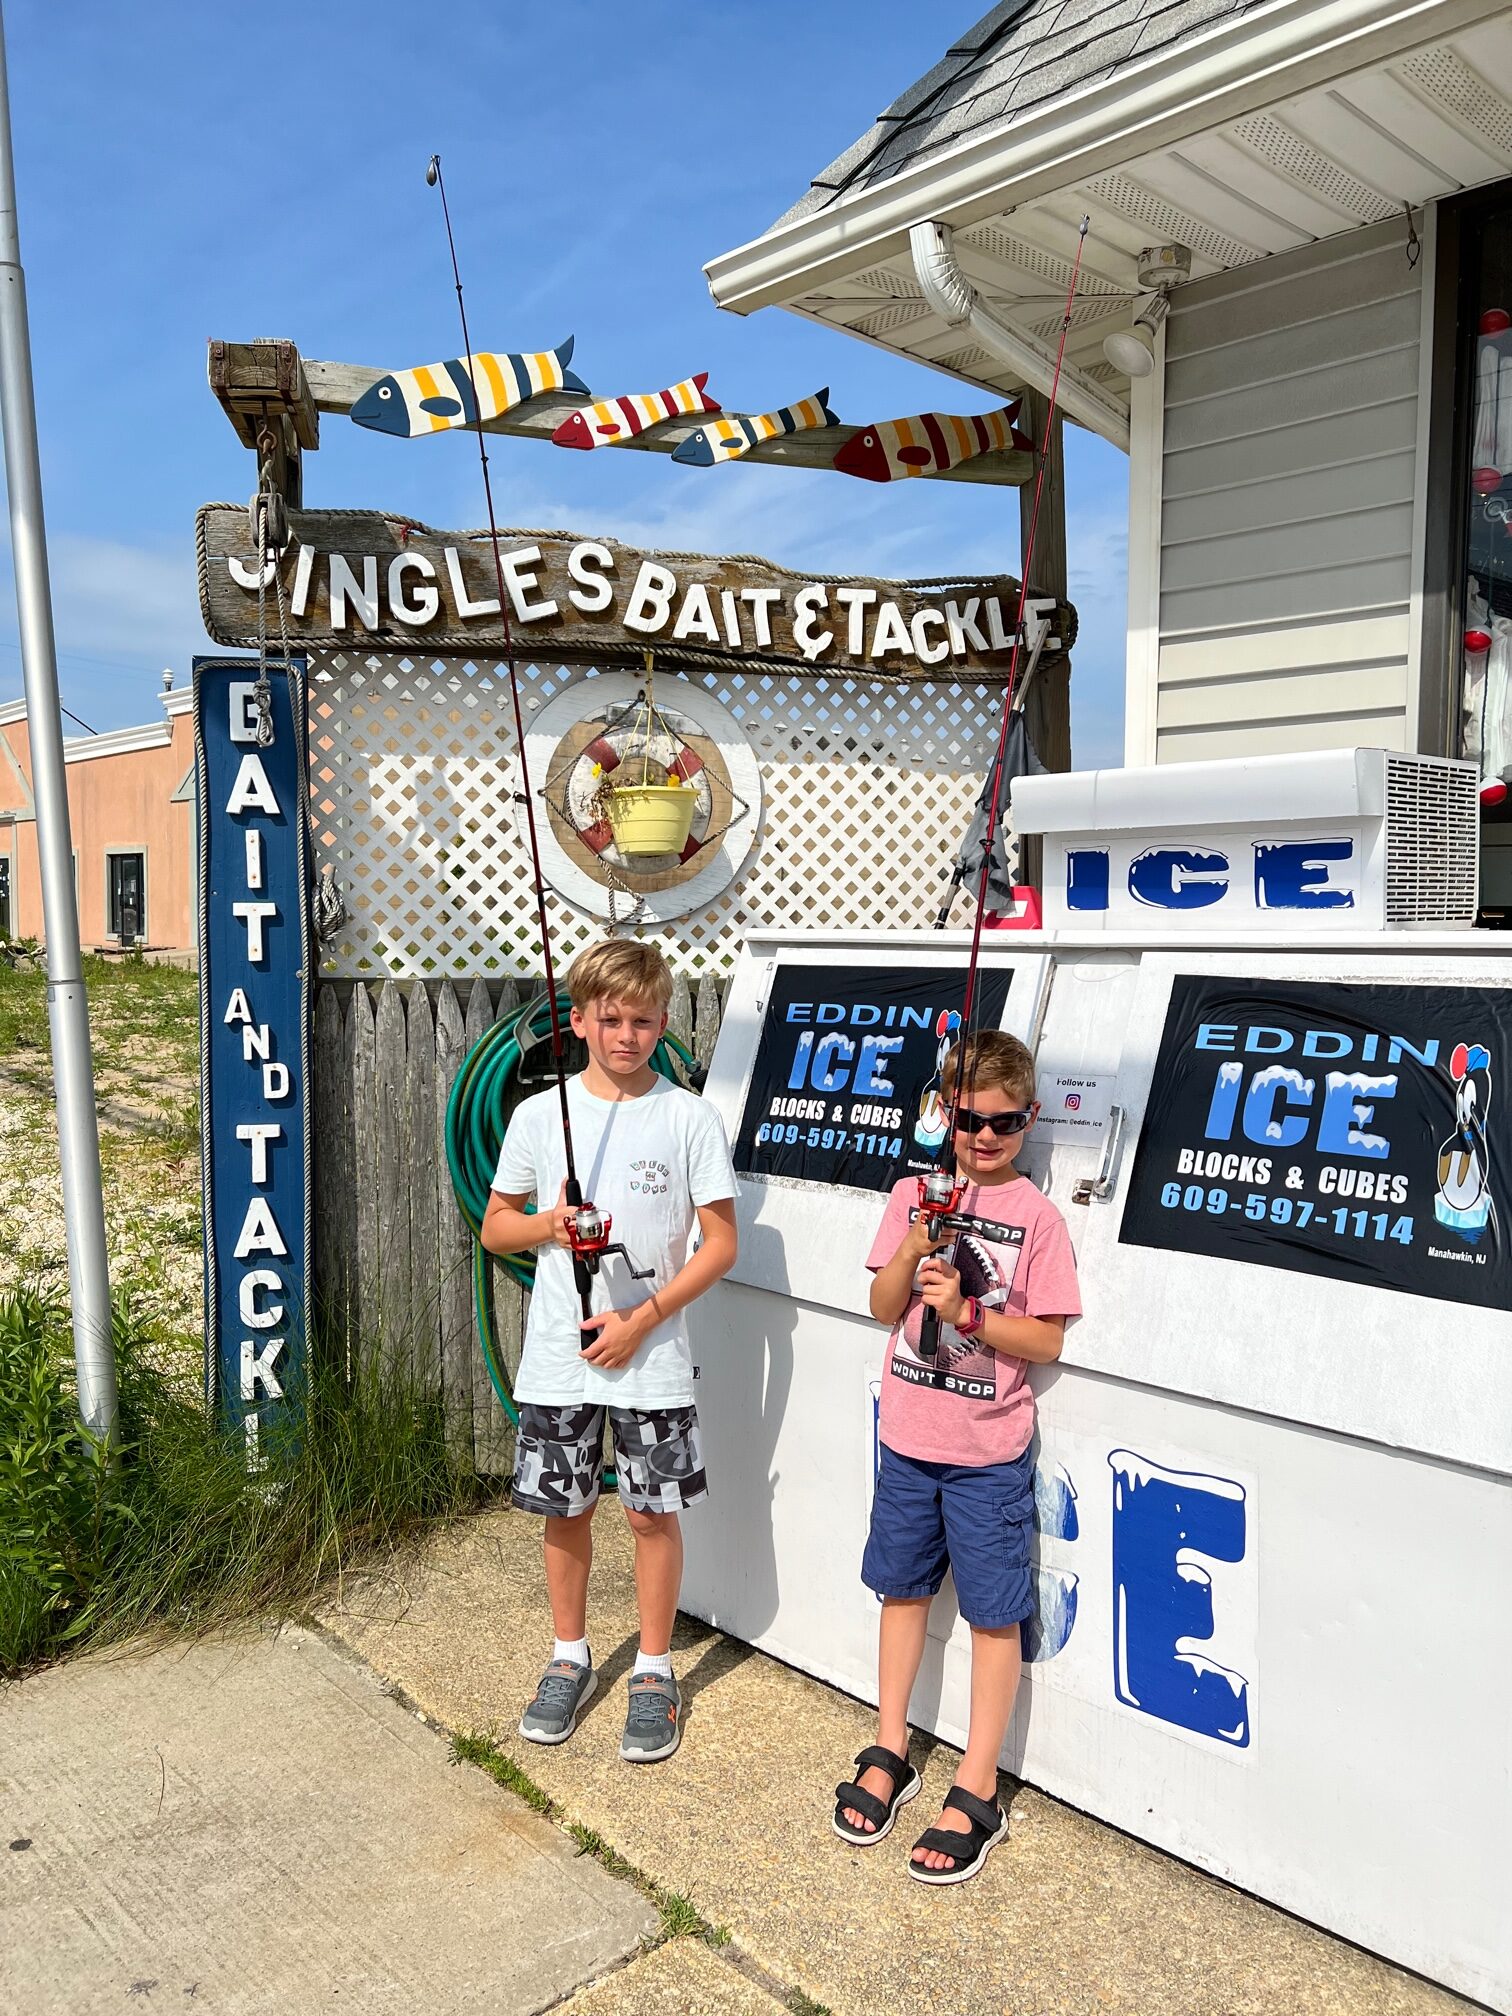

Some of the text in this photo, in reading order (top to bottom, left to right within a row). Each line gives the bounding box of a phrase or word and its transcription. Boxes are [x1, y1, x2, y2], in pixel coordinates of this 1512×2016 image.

[623, 560, 781, 647] BAIT
[793, 583, 834, 661] &
[837, 588, 1062, 664] TACKLE
[225, 682, 280, 962] BAIT
[1065, 837, 1355, 911] ICE
[223, 988, 289, 1098] AND
[786, 1003, 934, 1029] EDDIN
[787, 1031, 905, 1098] ICE
[1195, 1023, 1440, 1066] EDDIN
[1056, 1078, 1085, 1087] Follow
[1204, 1061, 1399, 1159] ICE
[759, 1122, 903, 1159] 609-597-1114
[769, 1096, 903, 1130] BLOCKS & CUBES
[1037, 1116, 1068, 1125] Instagram:
[1177, 1148, 1409, 1204] BLOCKS & CUBES
[1160, 1181, 1414, 1245] 609-597-1114
[1428, 1246, 1486, 1264] Manahawkin, NJ
[233, 1124, 288, 1506] TACKL
[892, 1361, 994, 1396] WON'T STOP
